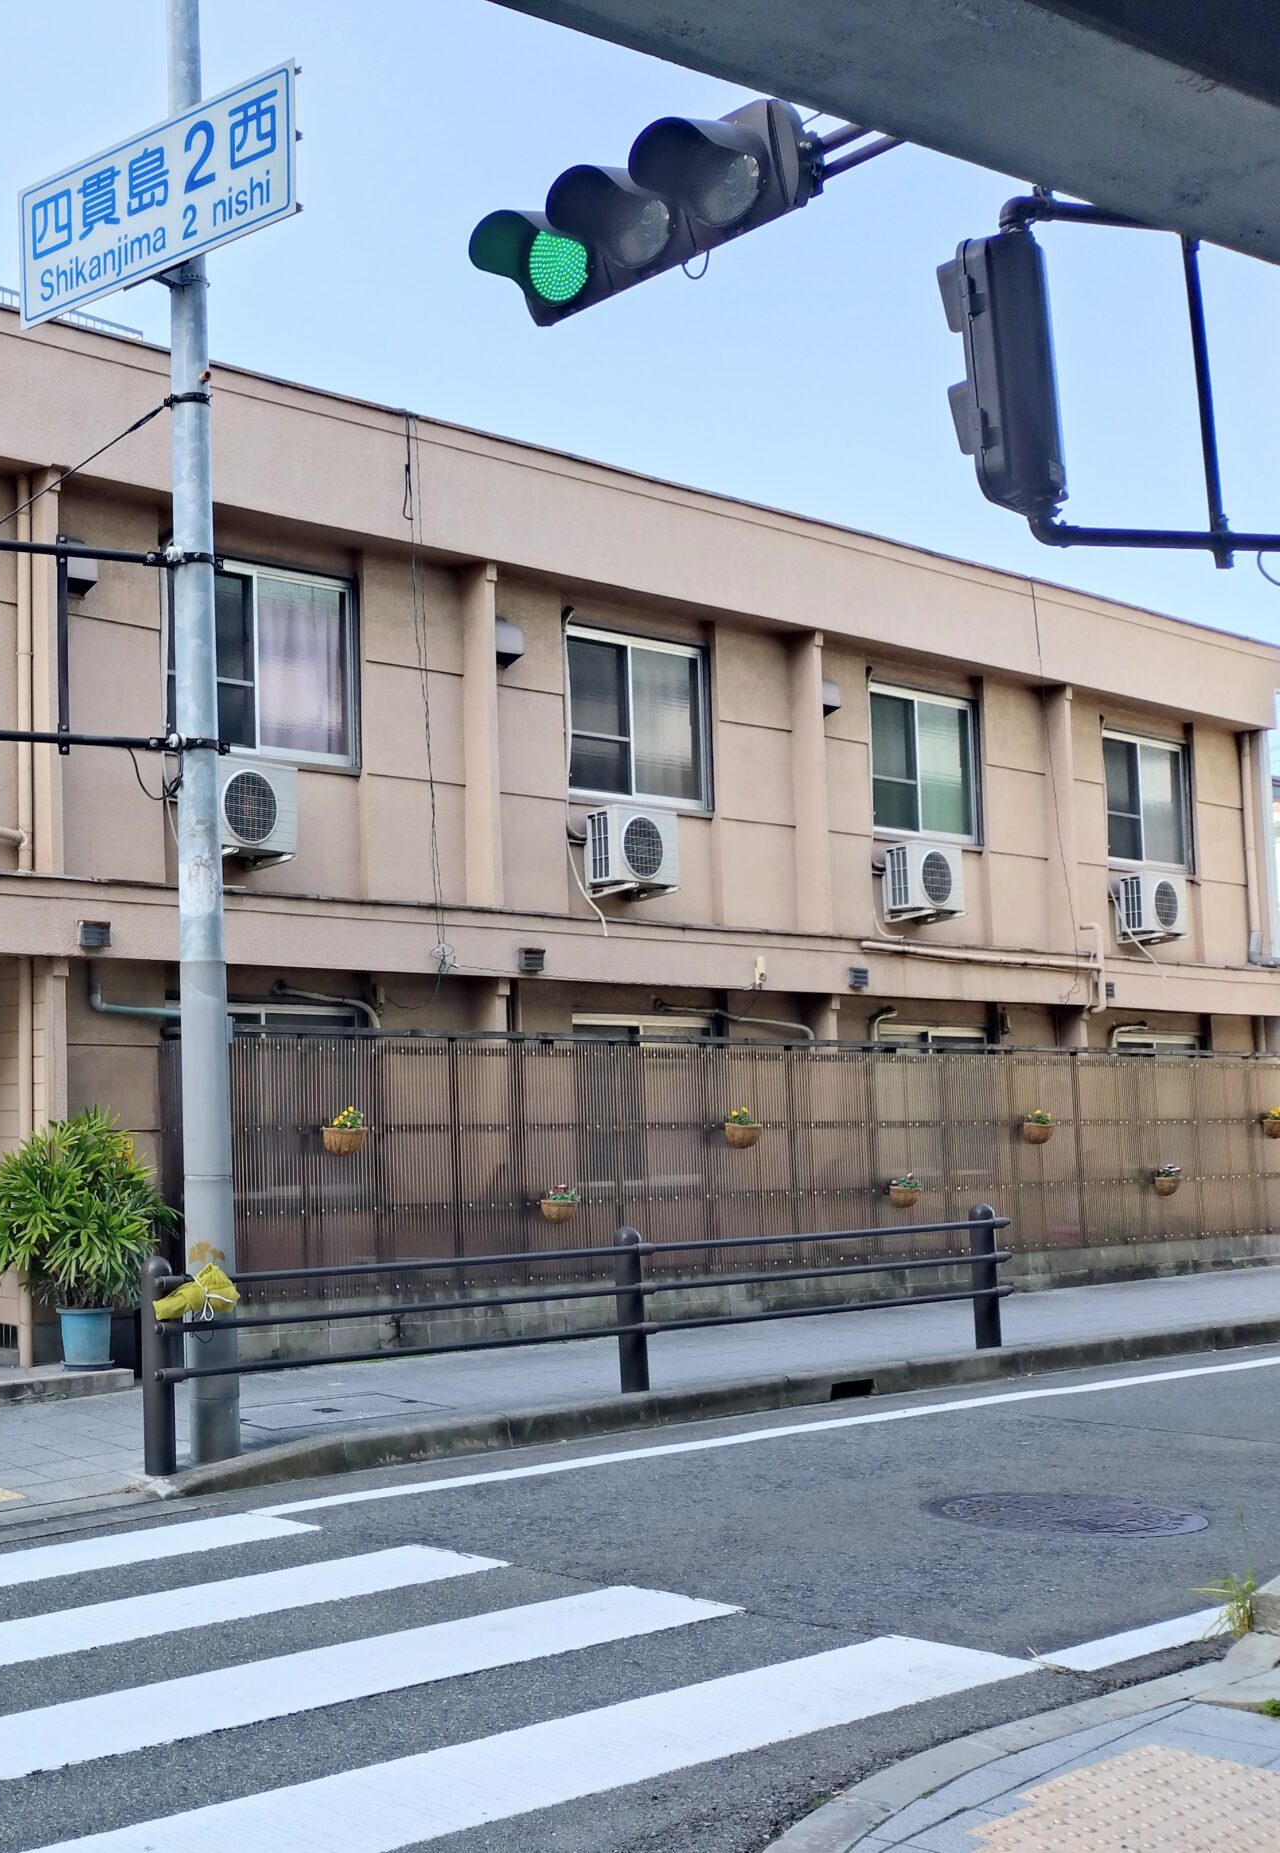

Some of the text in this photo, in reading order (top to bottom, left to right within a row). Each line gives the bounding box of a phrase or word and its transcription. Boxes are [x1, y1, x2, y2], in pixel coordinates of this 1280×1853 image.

[31, 88, 279, 261] 四貫島2西
[39, 168, 271, 302] Shikanjima 2 nishi
